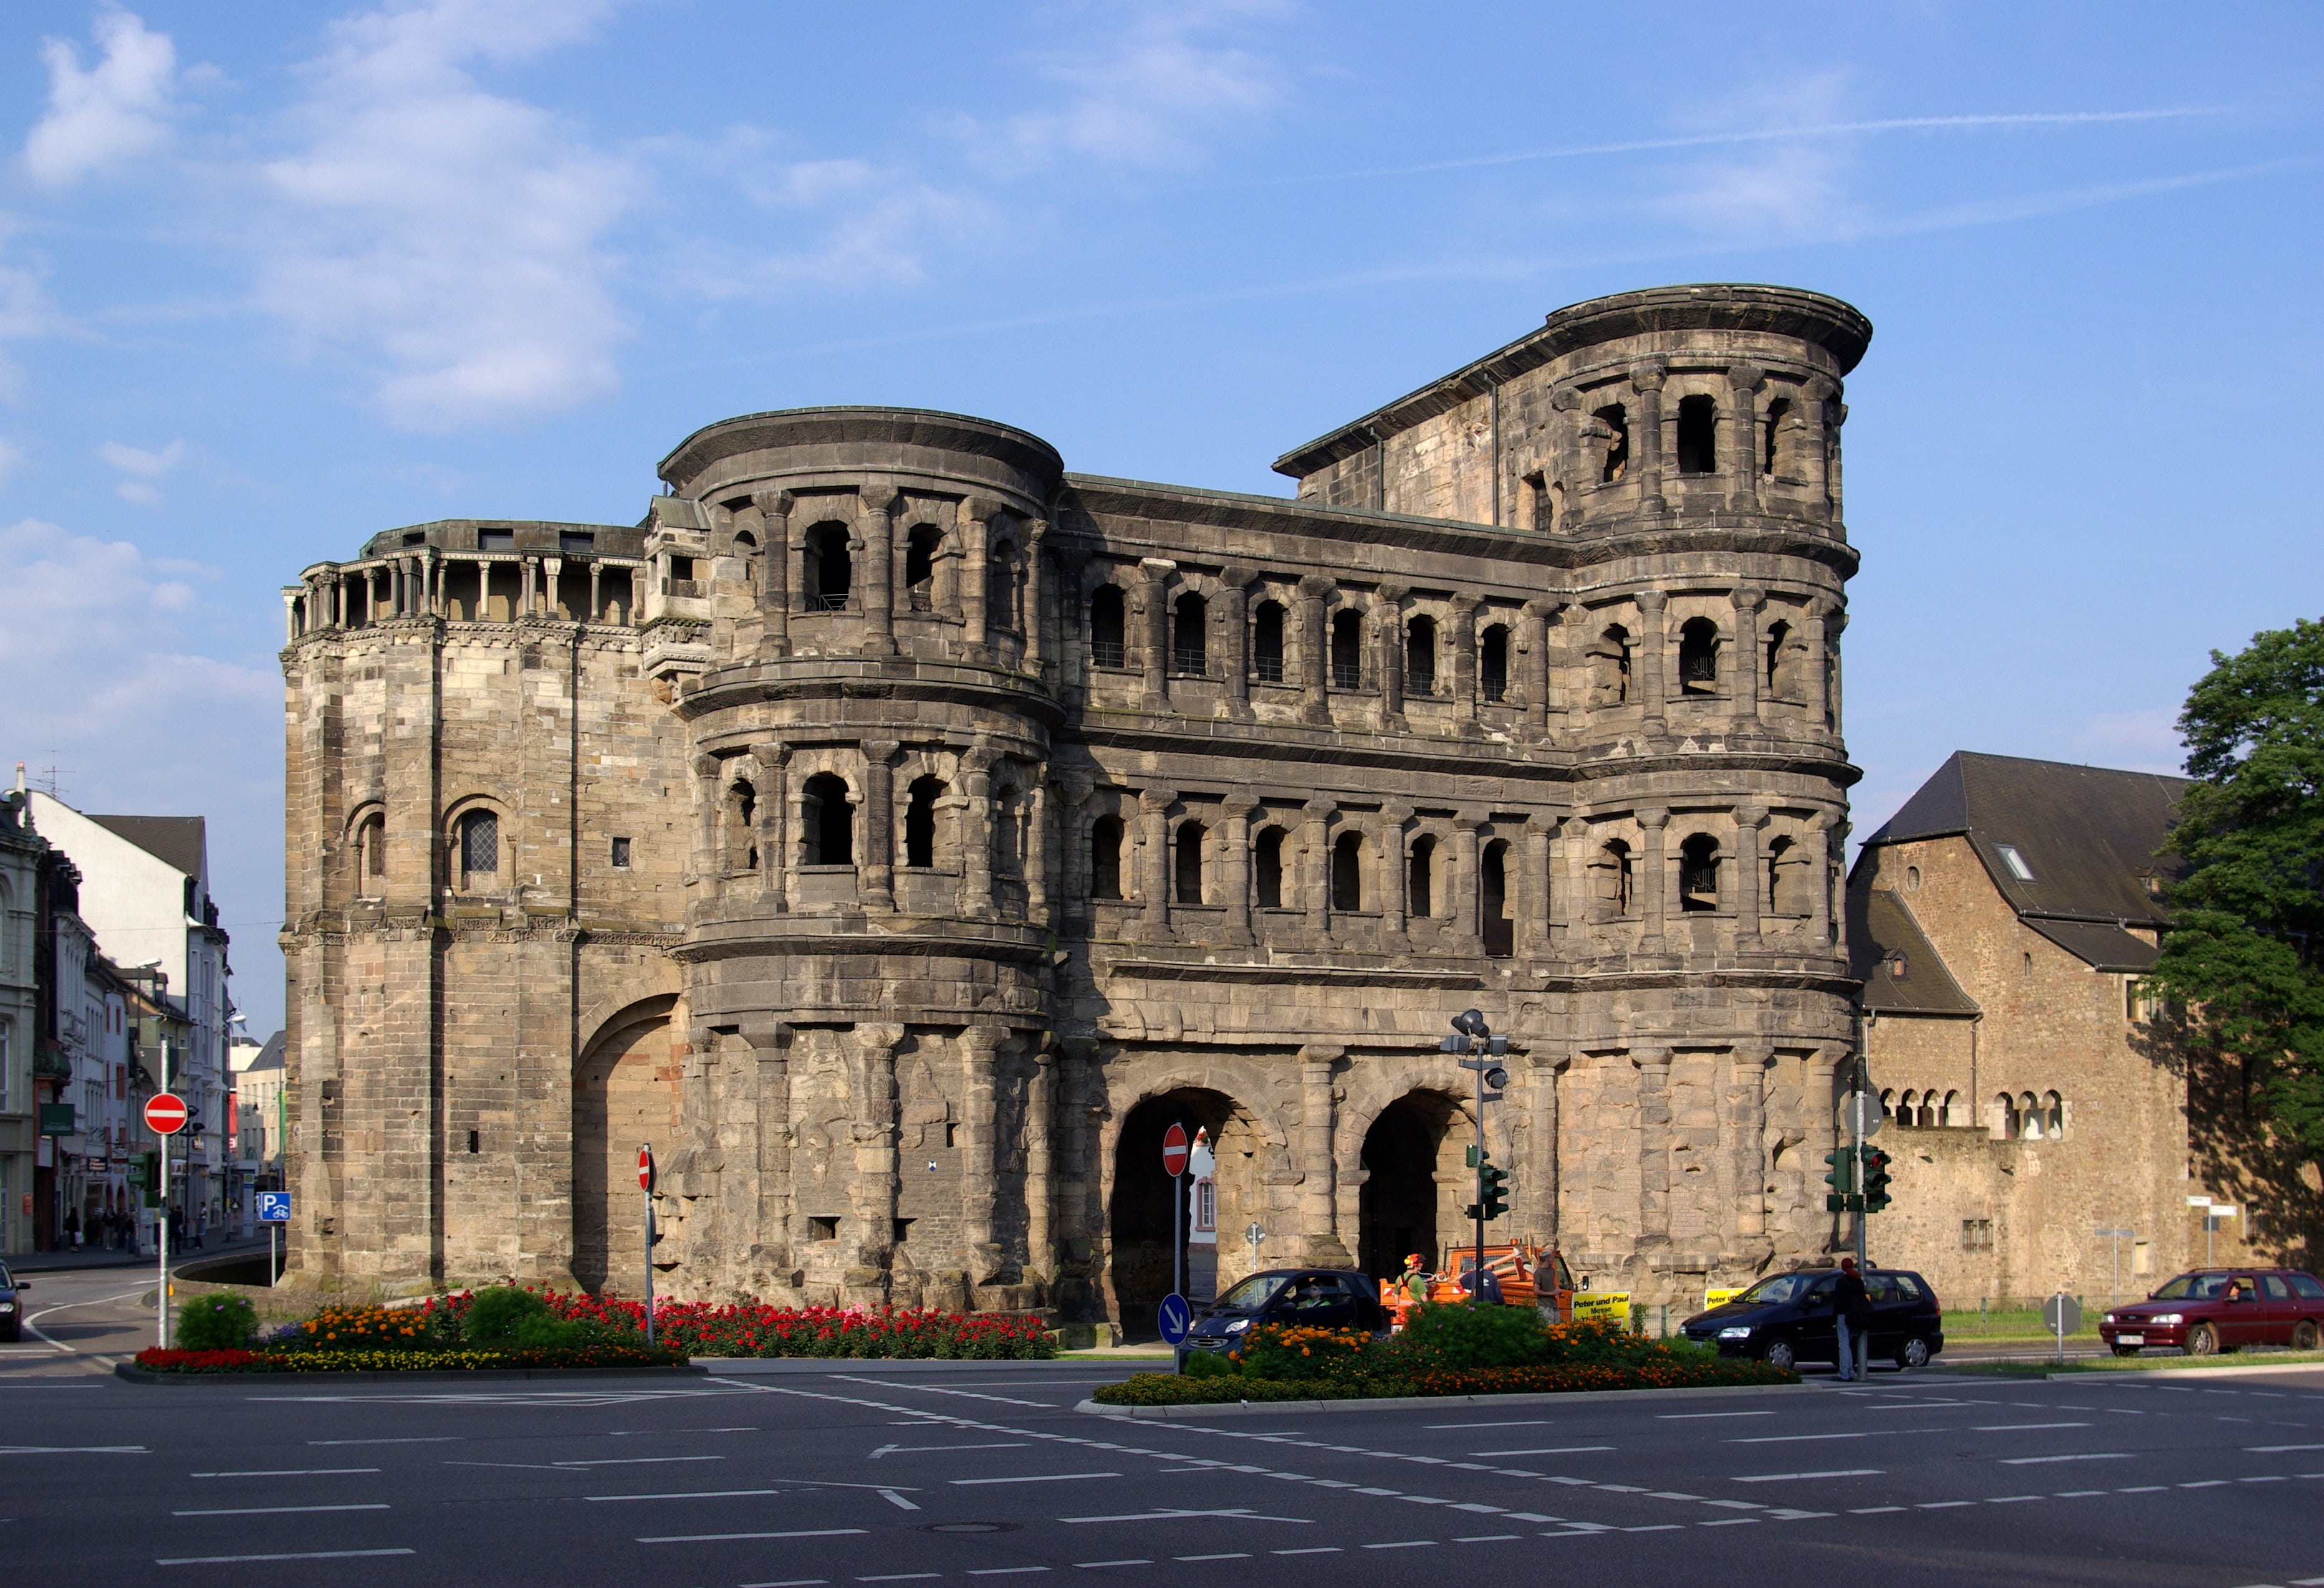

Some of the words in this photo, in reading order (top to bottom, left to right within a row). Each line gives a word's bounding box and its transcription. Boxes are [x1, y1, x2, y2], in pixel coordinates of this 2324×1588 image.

[264, 1195, 277, 1212] P
[1574, 1300, 1595, 1308] Peter
[1596, 1297, 1610, 1305] und
[1612, 1294, 1629, 1303] Paul
[1707, 1296, 1726, 1304] Peter
